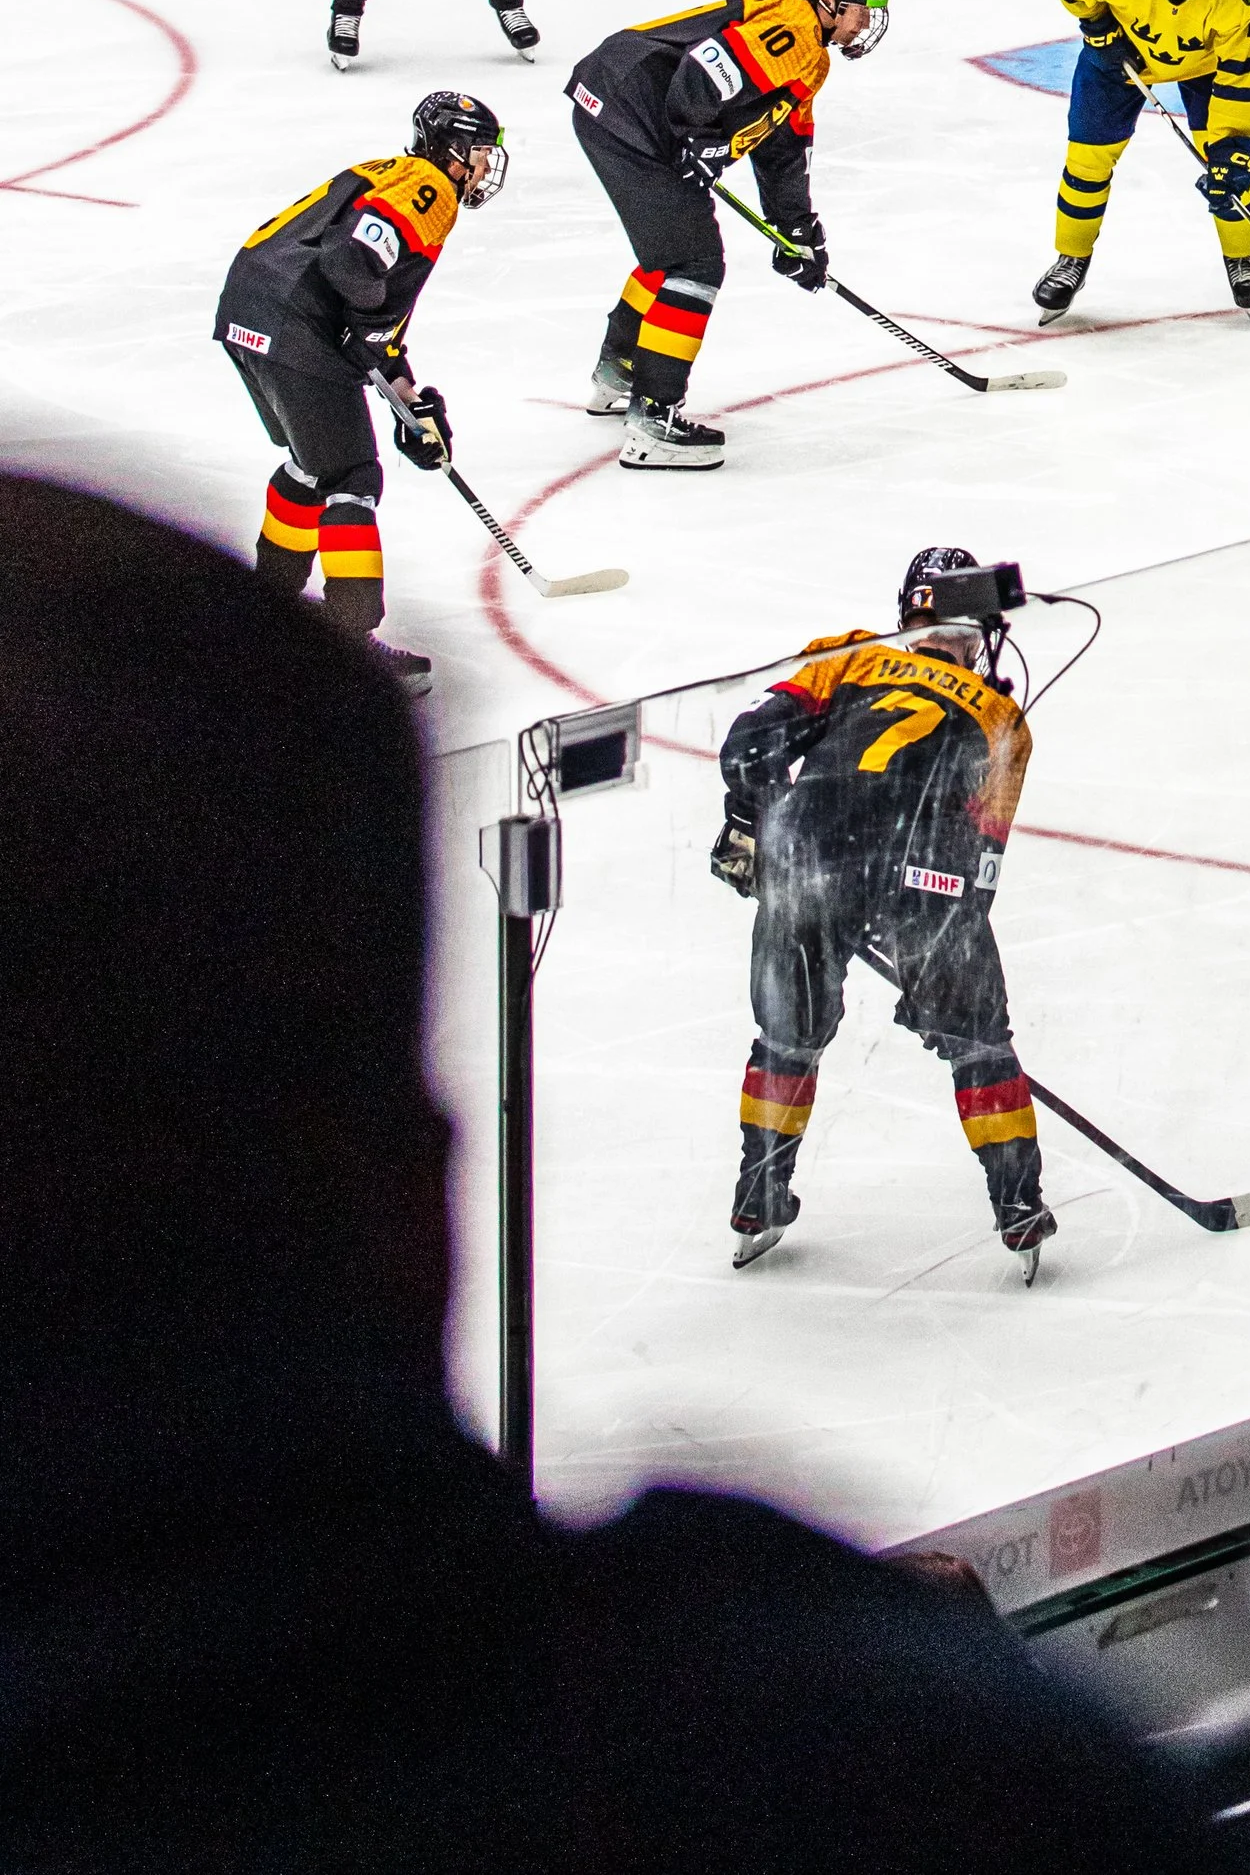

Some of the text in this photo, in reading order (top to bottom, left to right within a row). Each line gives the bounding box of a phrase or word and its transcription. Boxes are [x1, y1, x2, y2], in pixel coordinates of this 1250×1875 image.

[758, 24, 796, 58] 10
[412, 184, 438, 215] 9
[237, 328, 266, 349] IIHF
[858, 690, 947, 773] 7
[922, 870, 961, 894] IIHF
